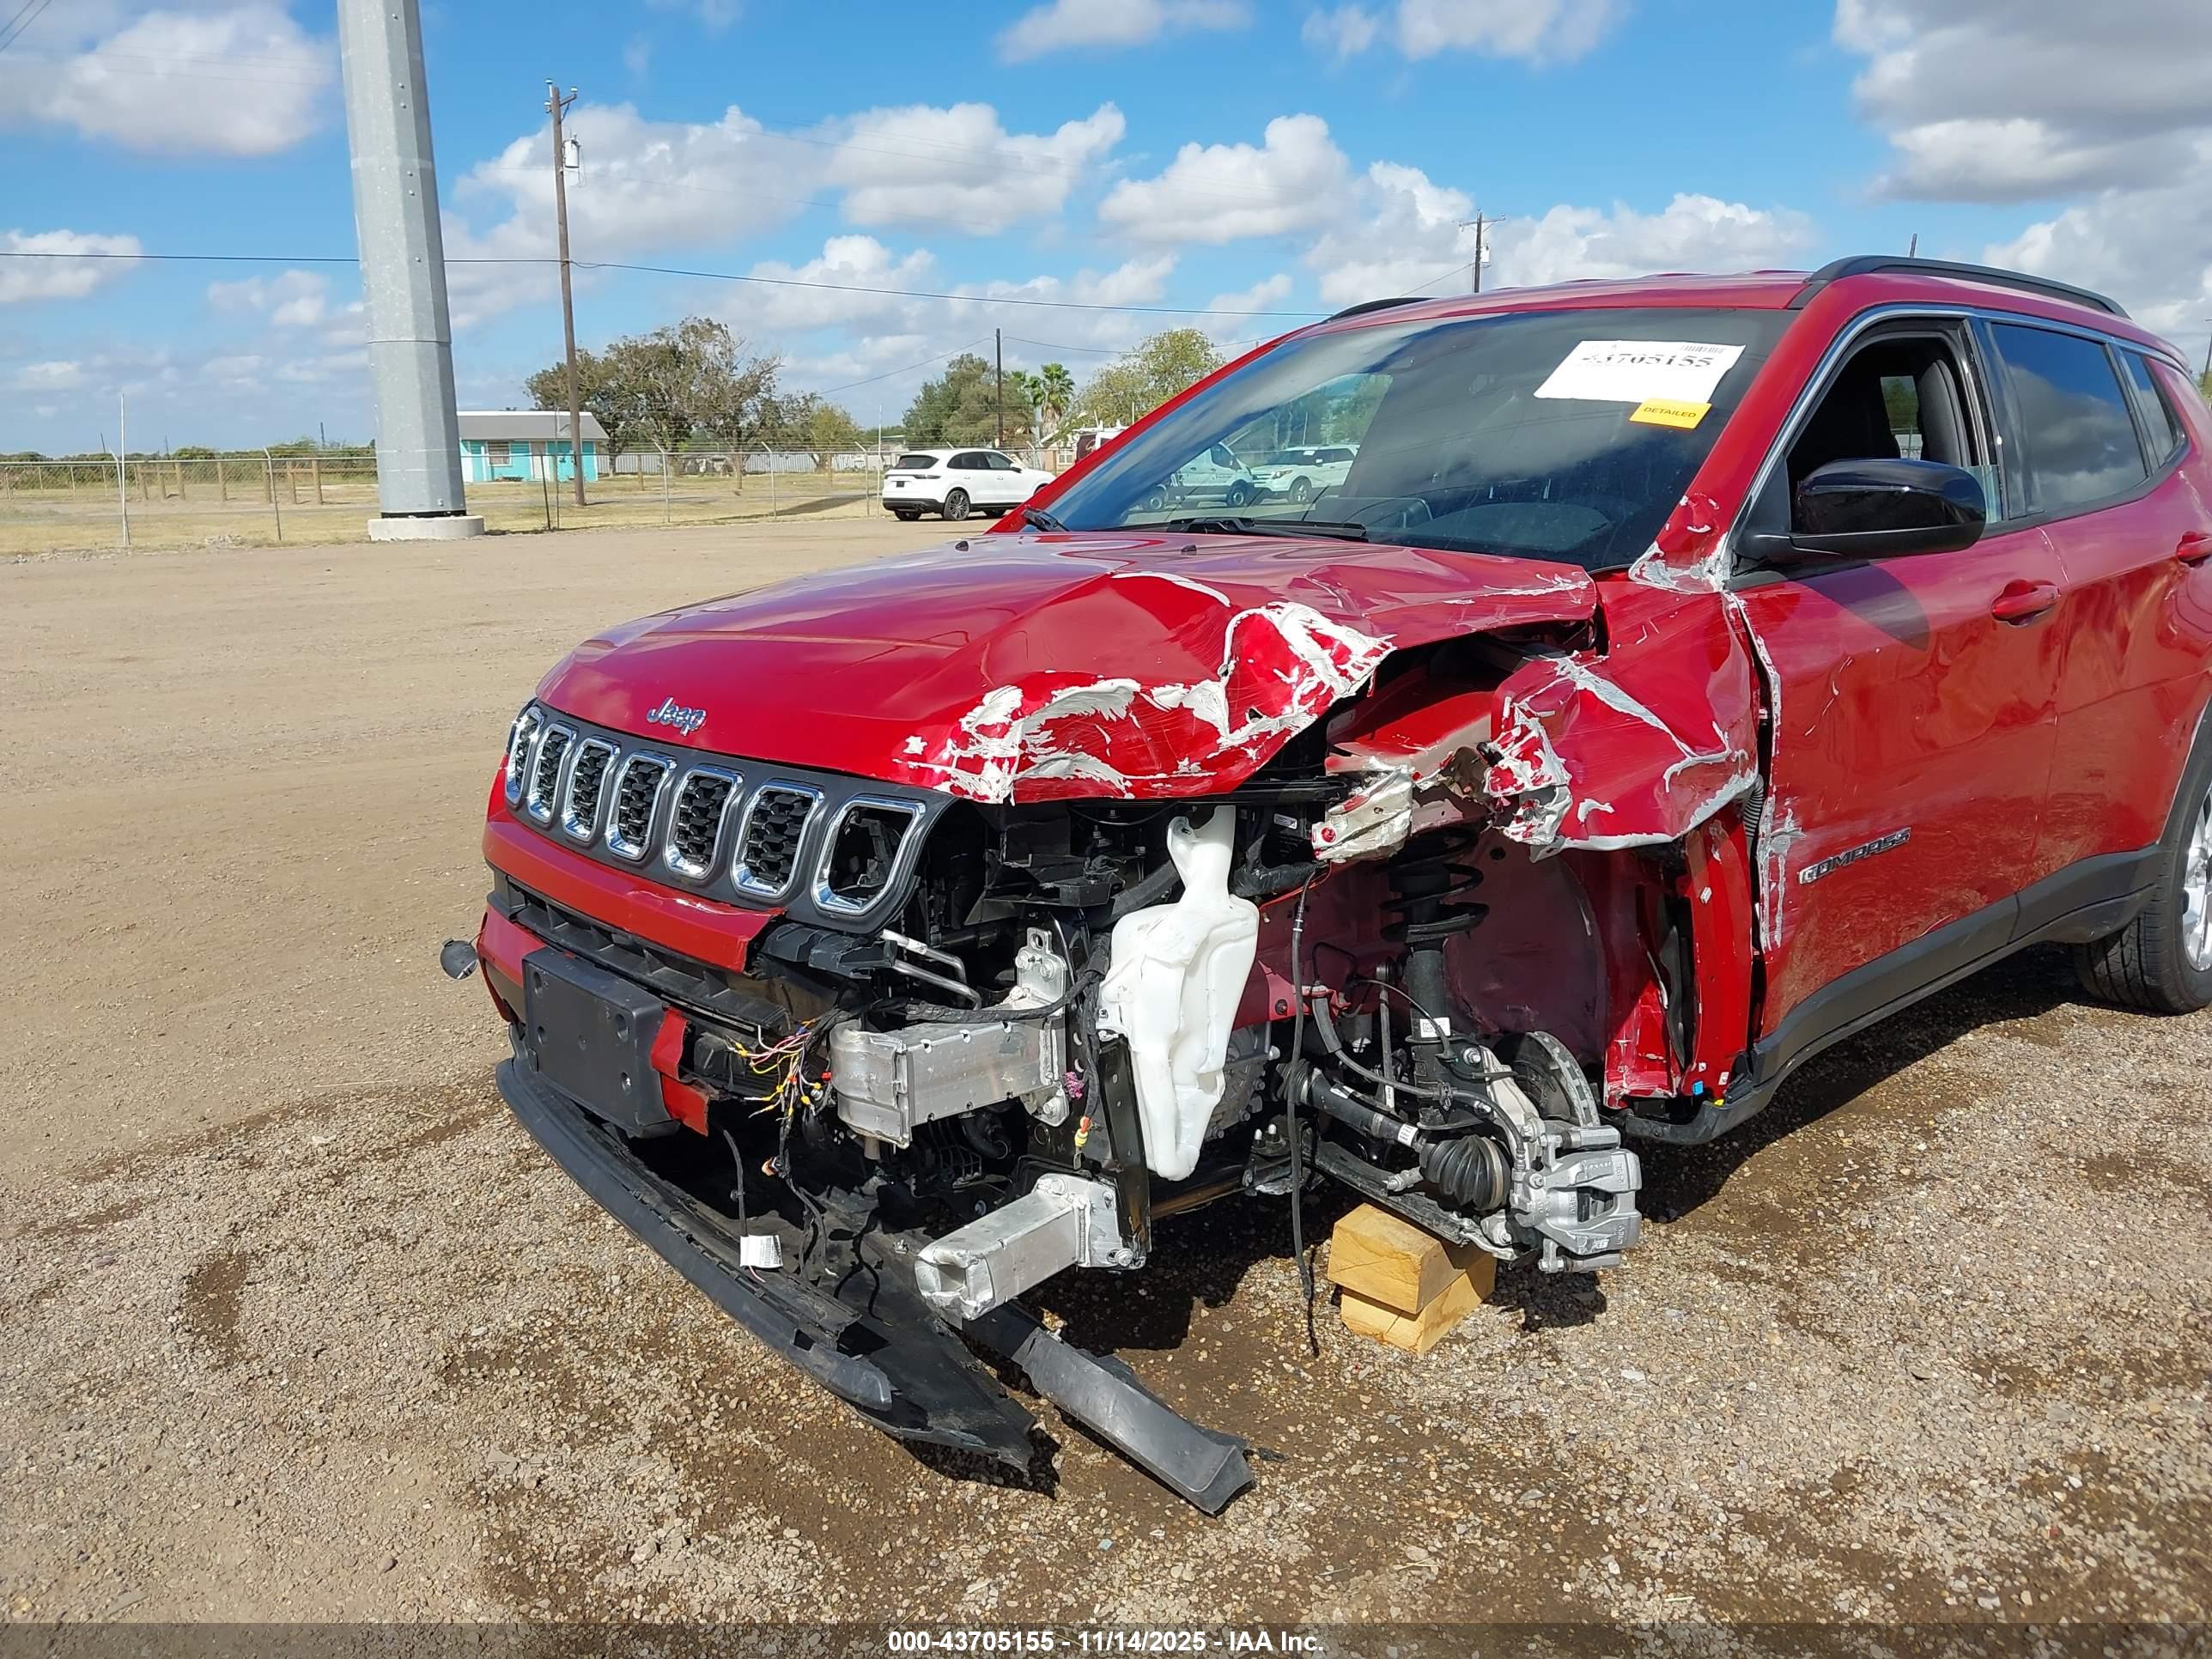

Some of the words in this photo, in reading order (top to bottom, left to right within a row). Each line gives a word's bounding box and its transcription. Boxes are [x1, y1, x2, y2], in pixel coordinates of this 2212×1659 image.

[1643, 405, 1698, 419] DETAILED
[647, 696, 707, 737] Jeep
[1799, 827, 1911, 885] COMPASS
